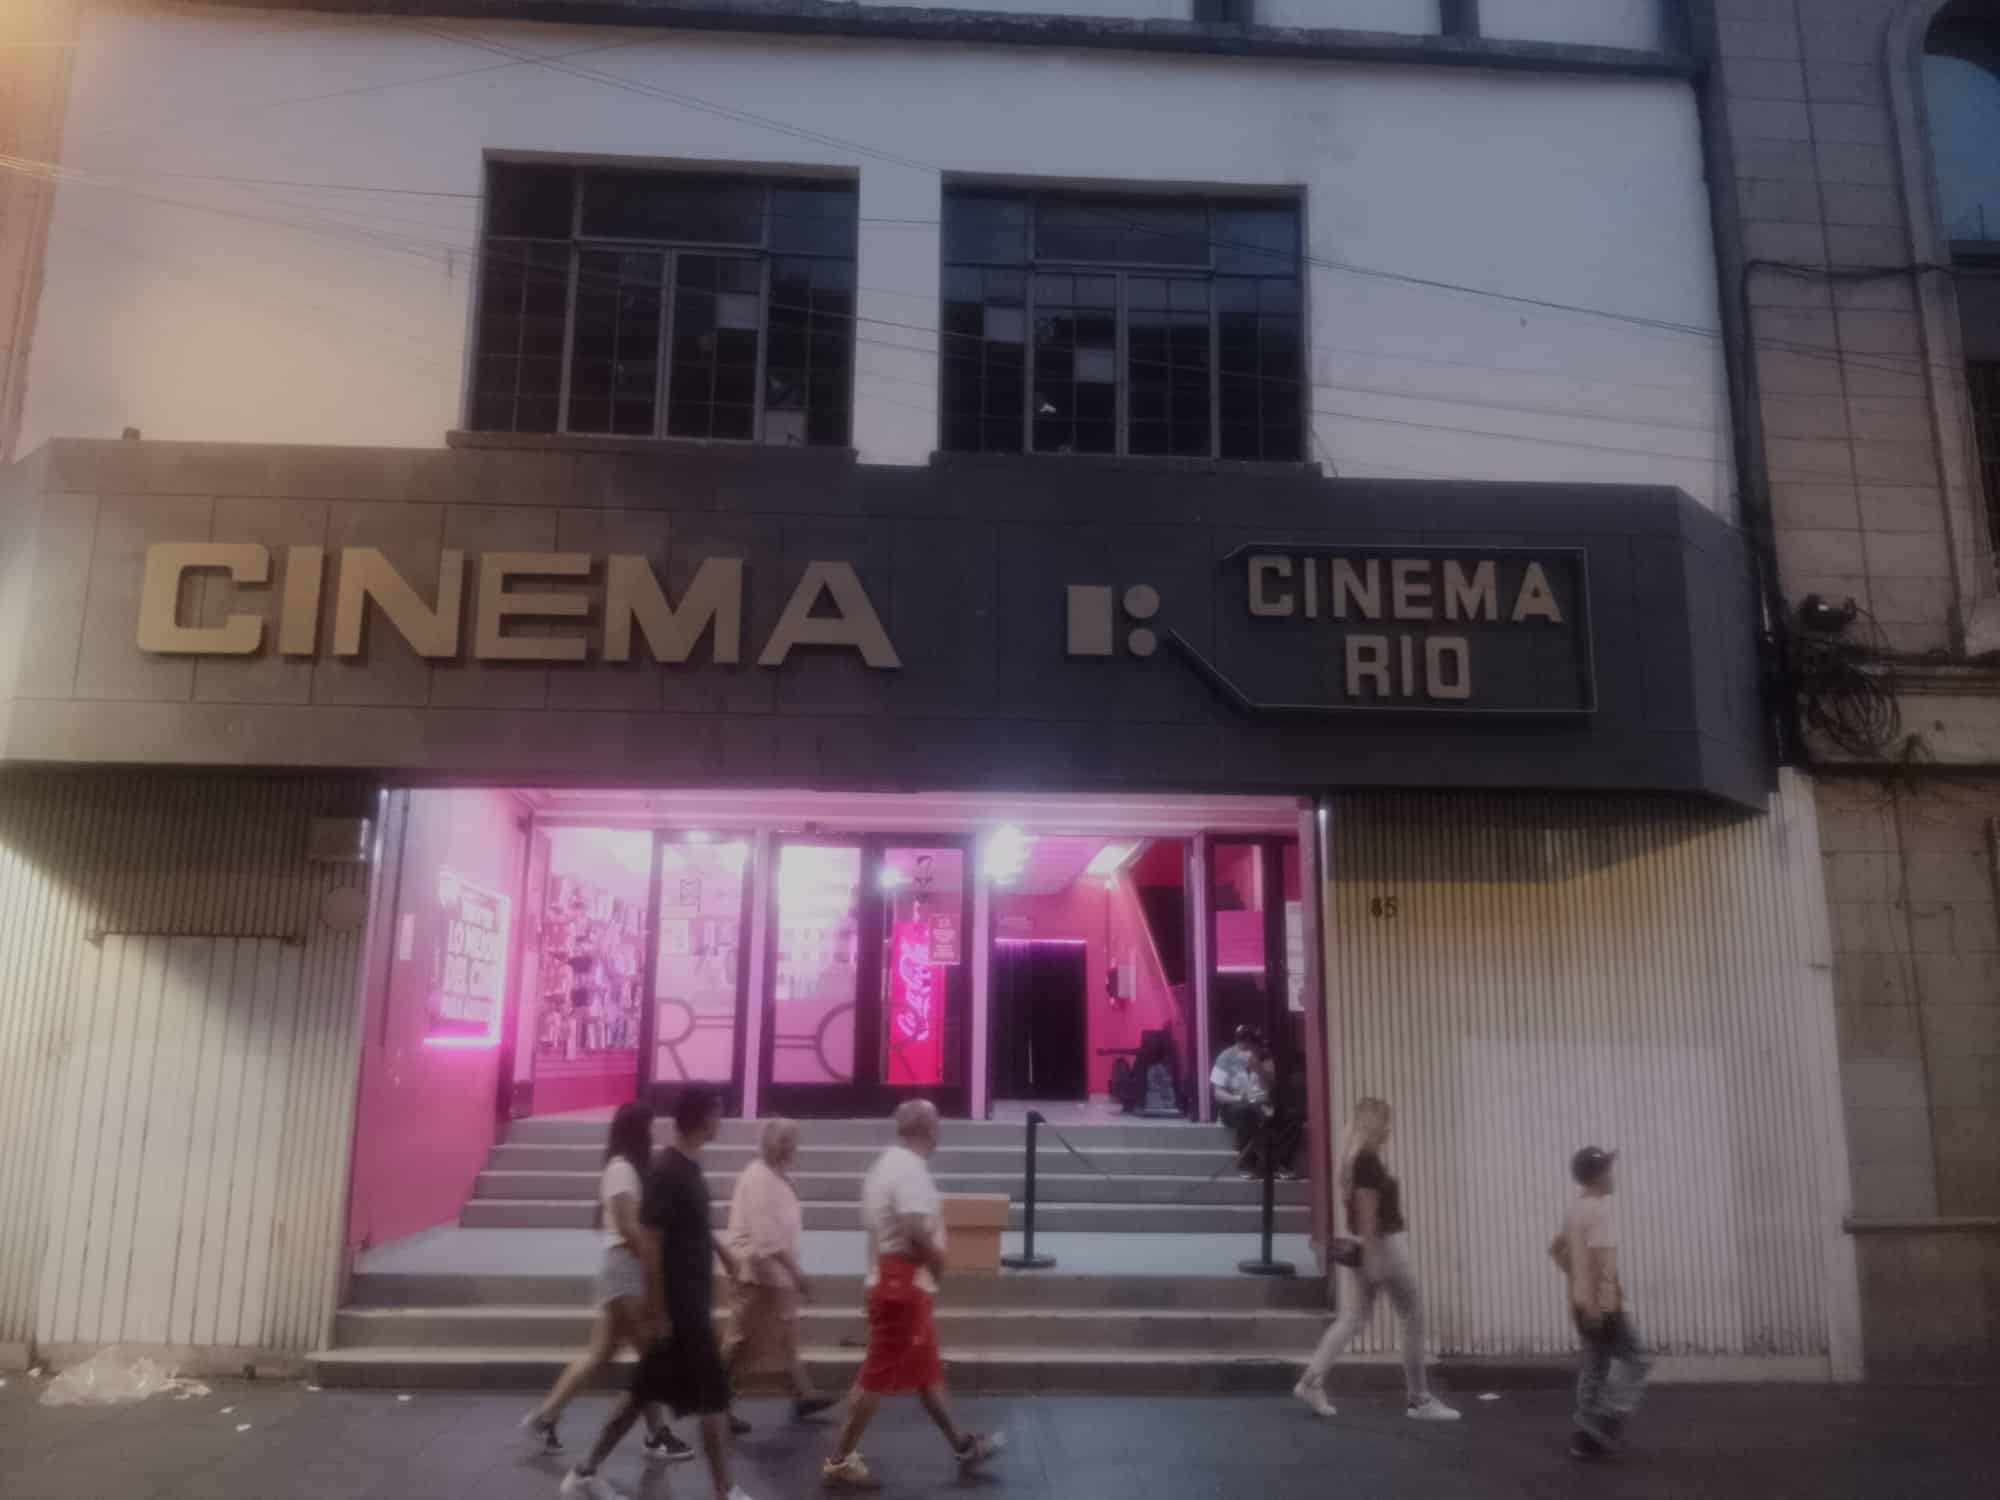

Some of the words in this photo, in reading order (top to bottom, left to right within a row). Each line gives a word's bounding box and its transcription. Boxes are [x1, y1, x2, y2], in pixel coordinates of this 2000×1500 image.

[137, 542, 901, 670] CINEMA
[1248, 555, 1563, 623] CINEMA
[1345, 634, 1472, 700] RIO
